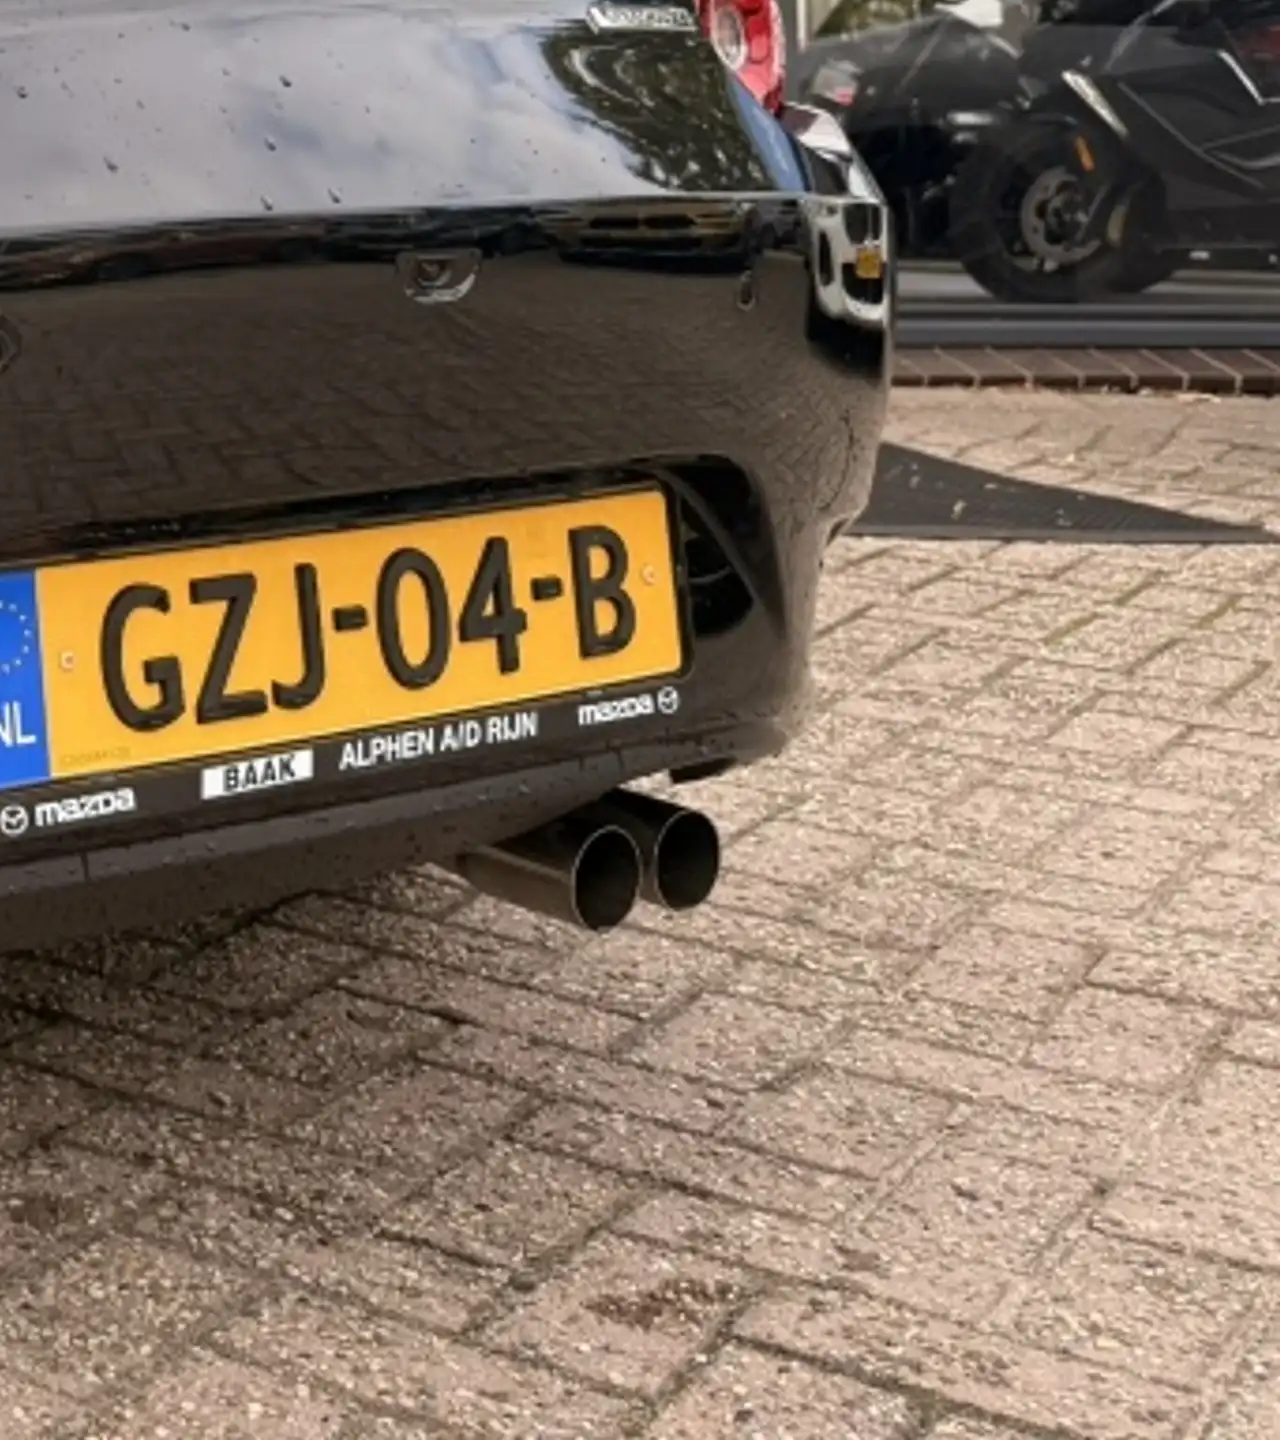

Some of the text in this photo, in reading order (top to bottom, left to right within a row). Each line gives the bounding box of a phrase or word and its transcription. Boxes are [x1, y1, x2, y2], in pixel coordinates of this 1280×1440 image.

[99, 523, 636, 734] GZJ-04-B
[222, 711, 539, 792] BAAK ALPHEN A/D RIJN
[34, 787, 137, 828] mazda
